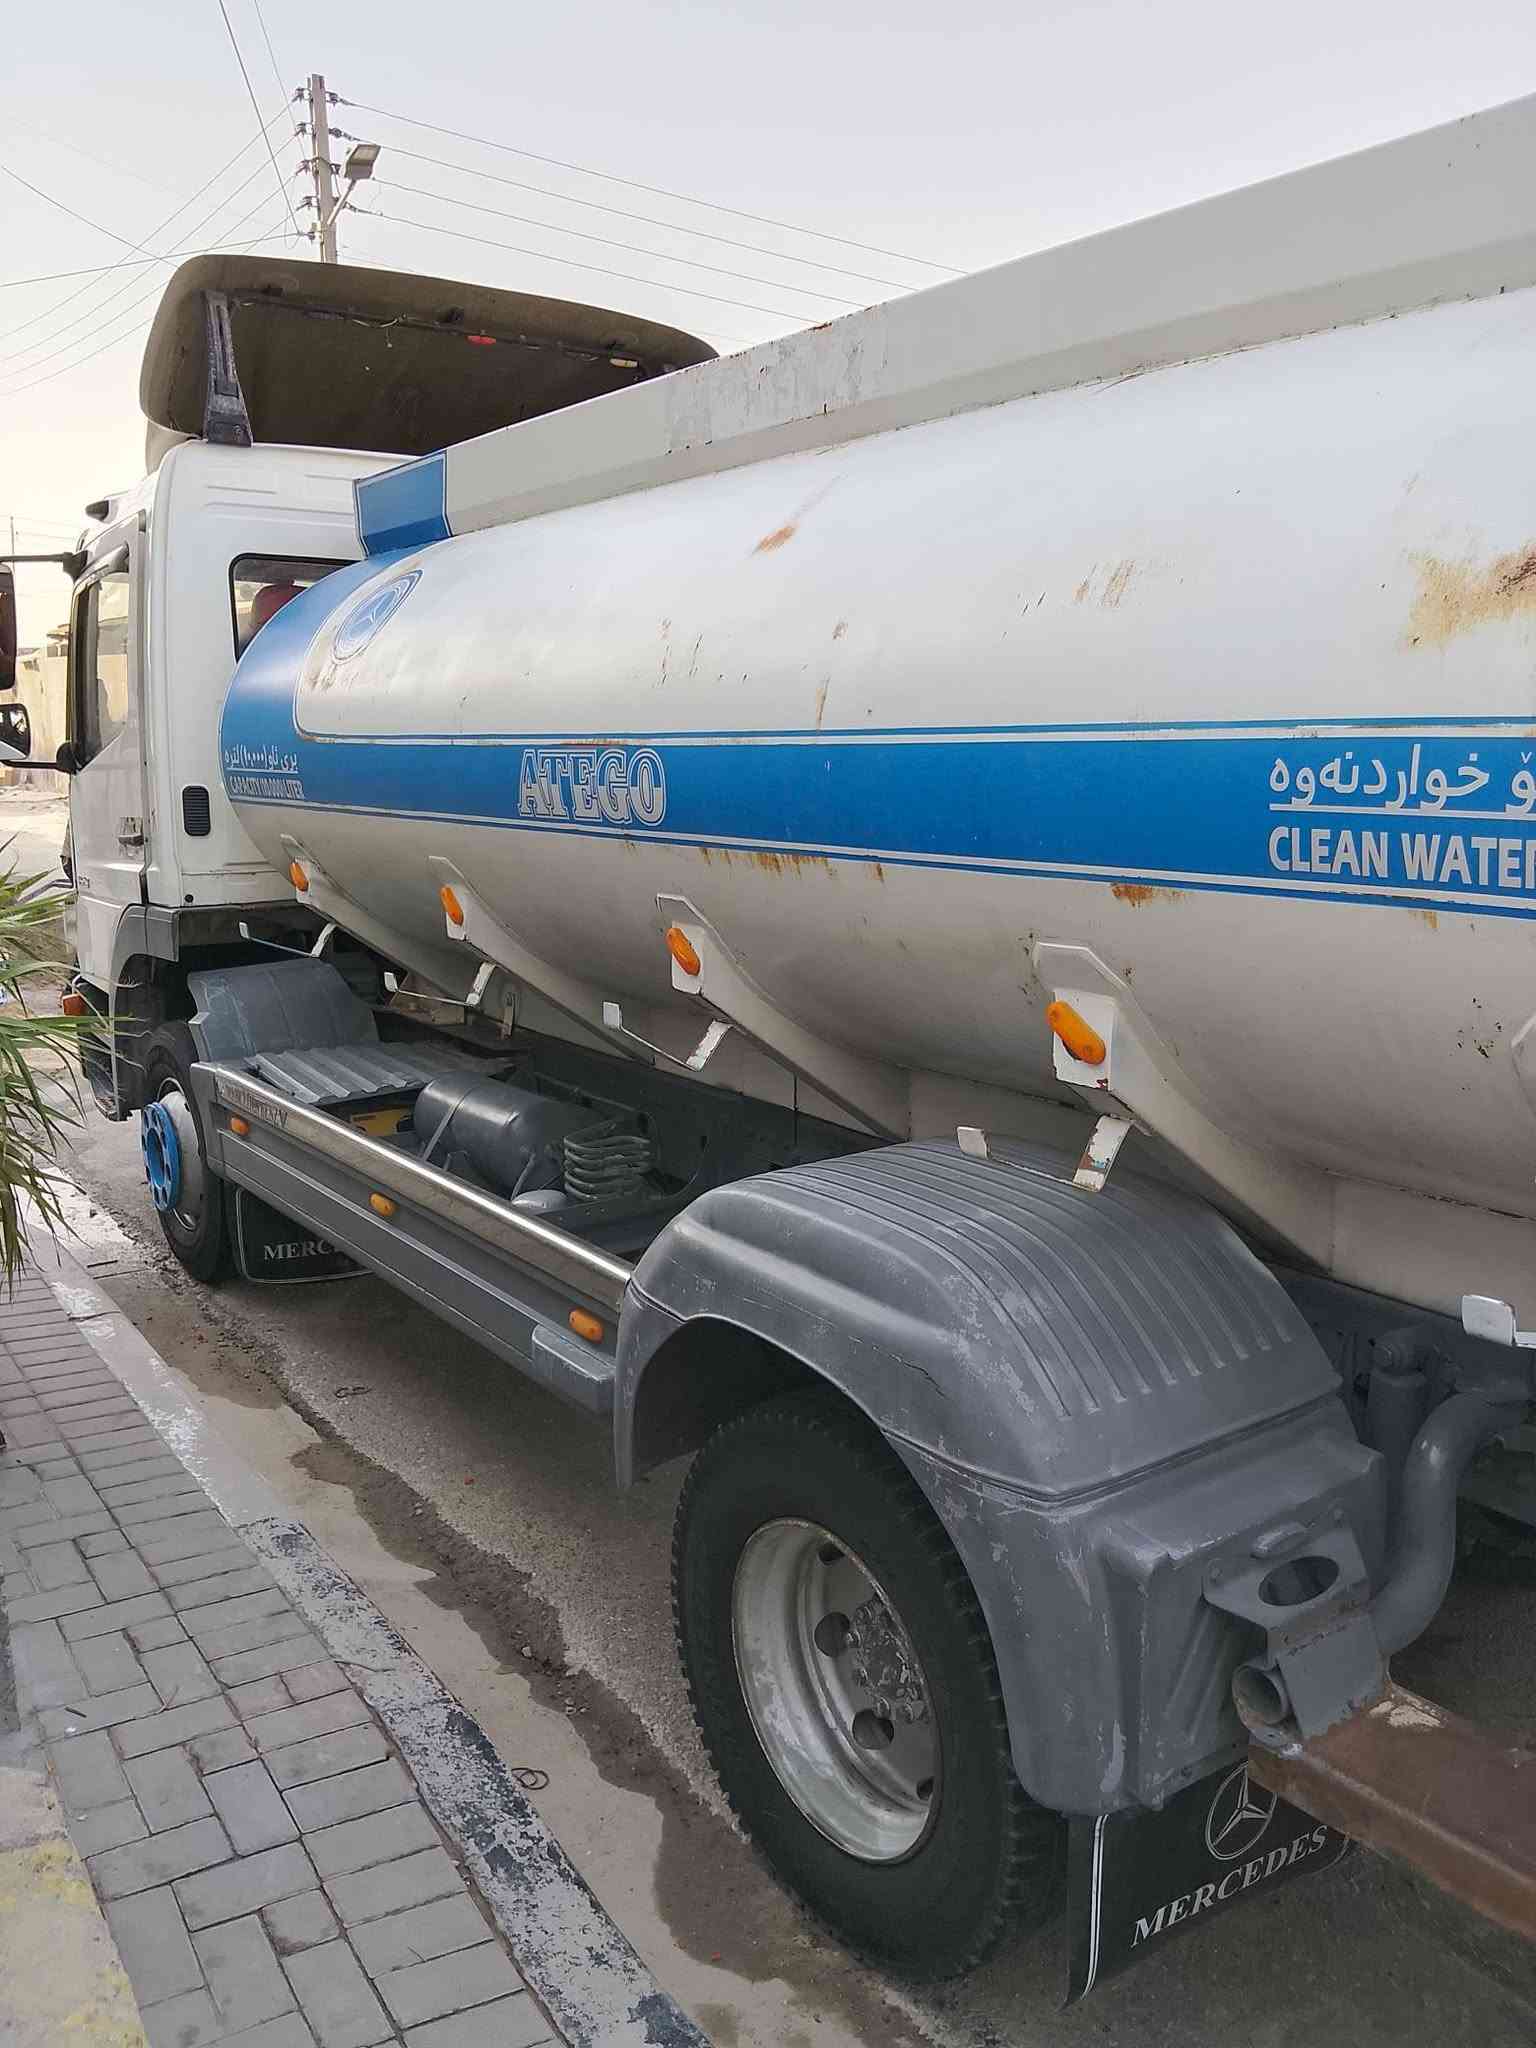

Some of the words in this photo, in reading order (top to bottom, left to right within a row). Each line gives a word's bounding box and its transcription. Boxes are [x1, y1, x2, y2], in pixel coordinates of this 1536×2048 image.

[517, 748, 666, 827] ATEGO
[1504, 751, 1536, 814] ۆ
[1269, 826, 1389, 878] CLEAN
[1130, 1824, 1328, 1949] MERCEDES
